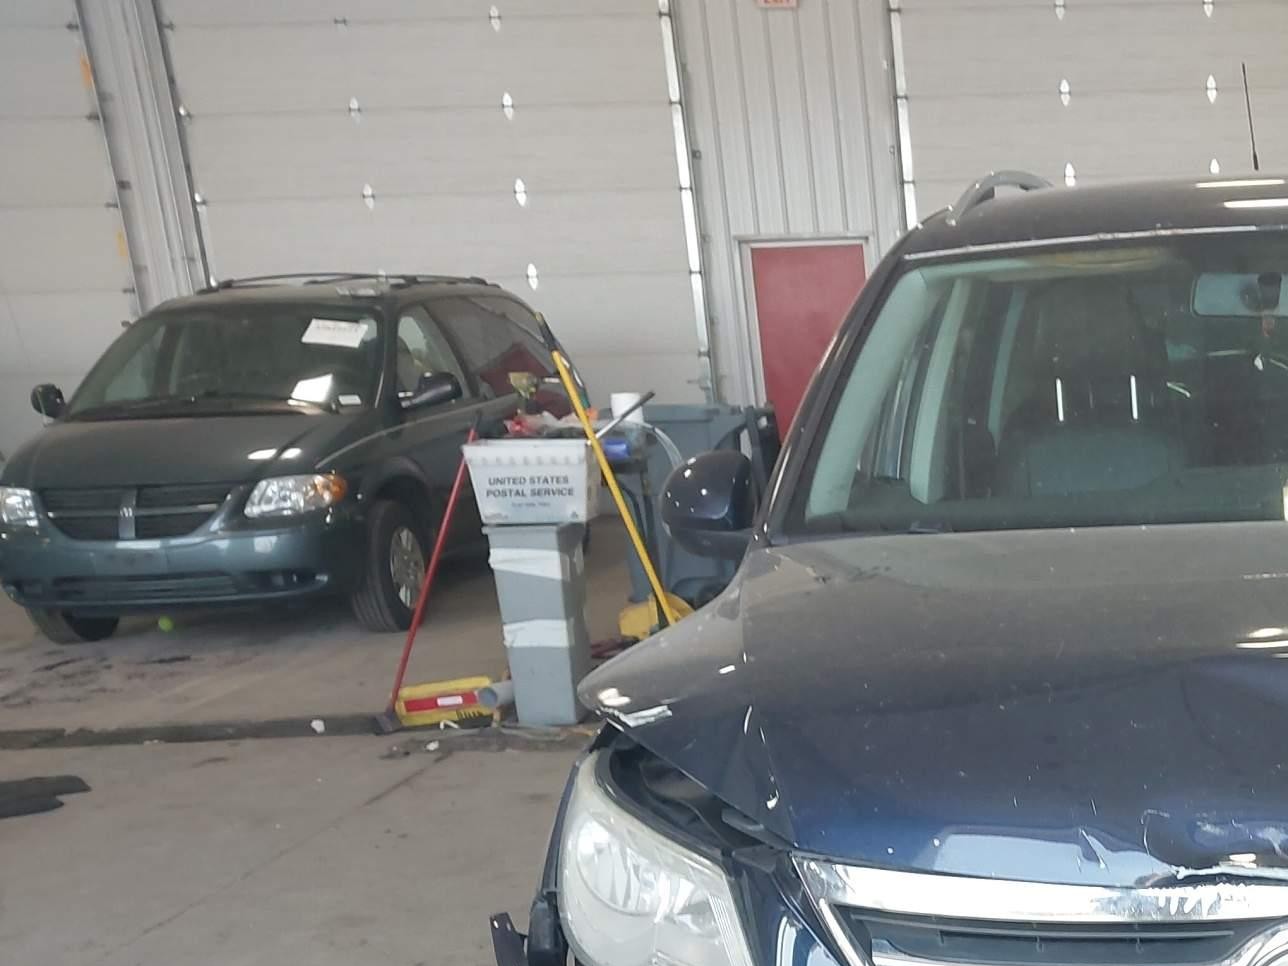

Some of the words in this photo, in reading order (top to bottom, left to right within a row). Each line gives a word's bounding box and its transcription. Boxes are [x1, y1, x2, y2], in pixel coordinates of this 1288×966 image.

[488, 476, 527, 487] UNITED
[529, 475, 569, 485] STATES
[486, 488, 527, 499] POSTAL
[530, 487, 574, 497] SERVICE
